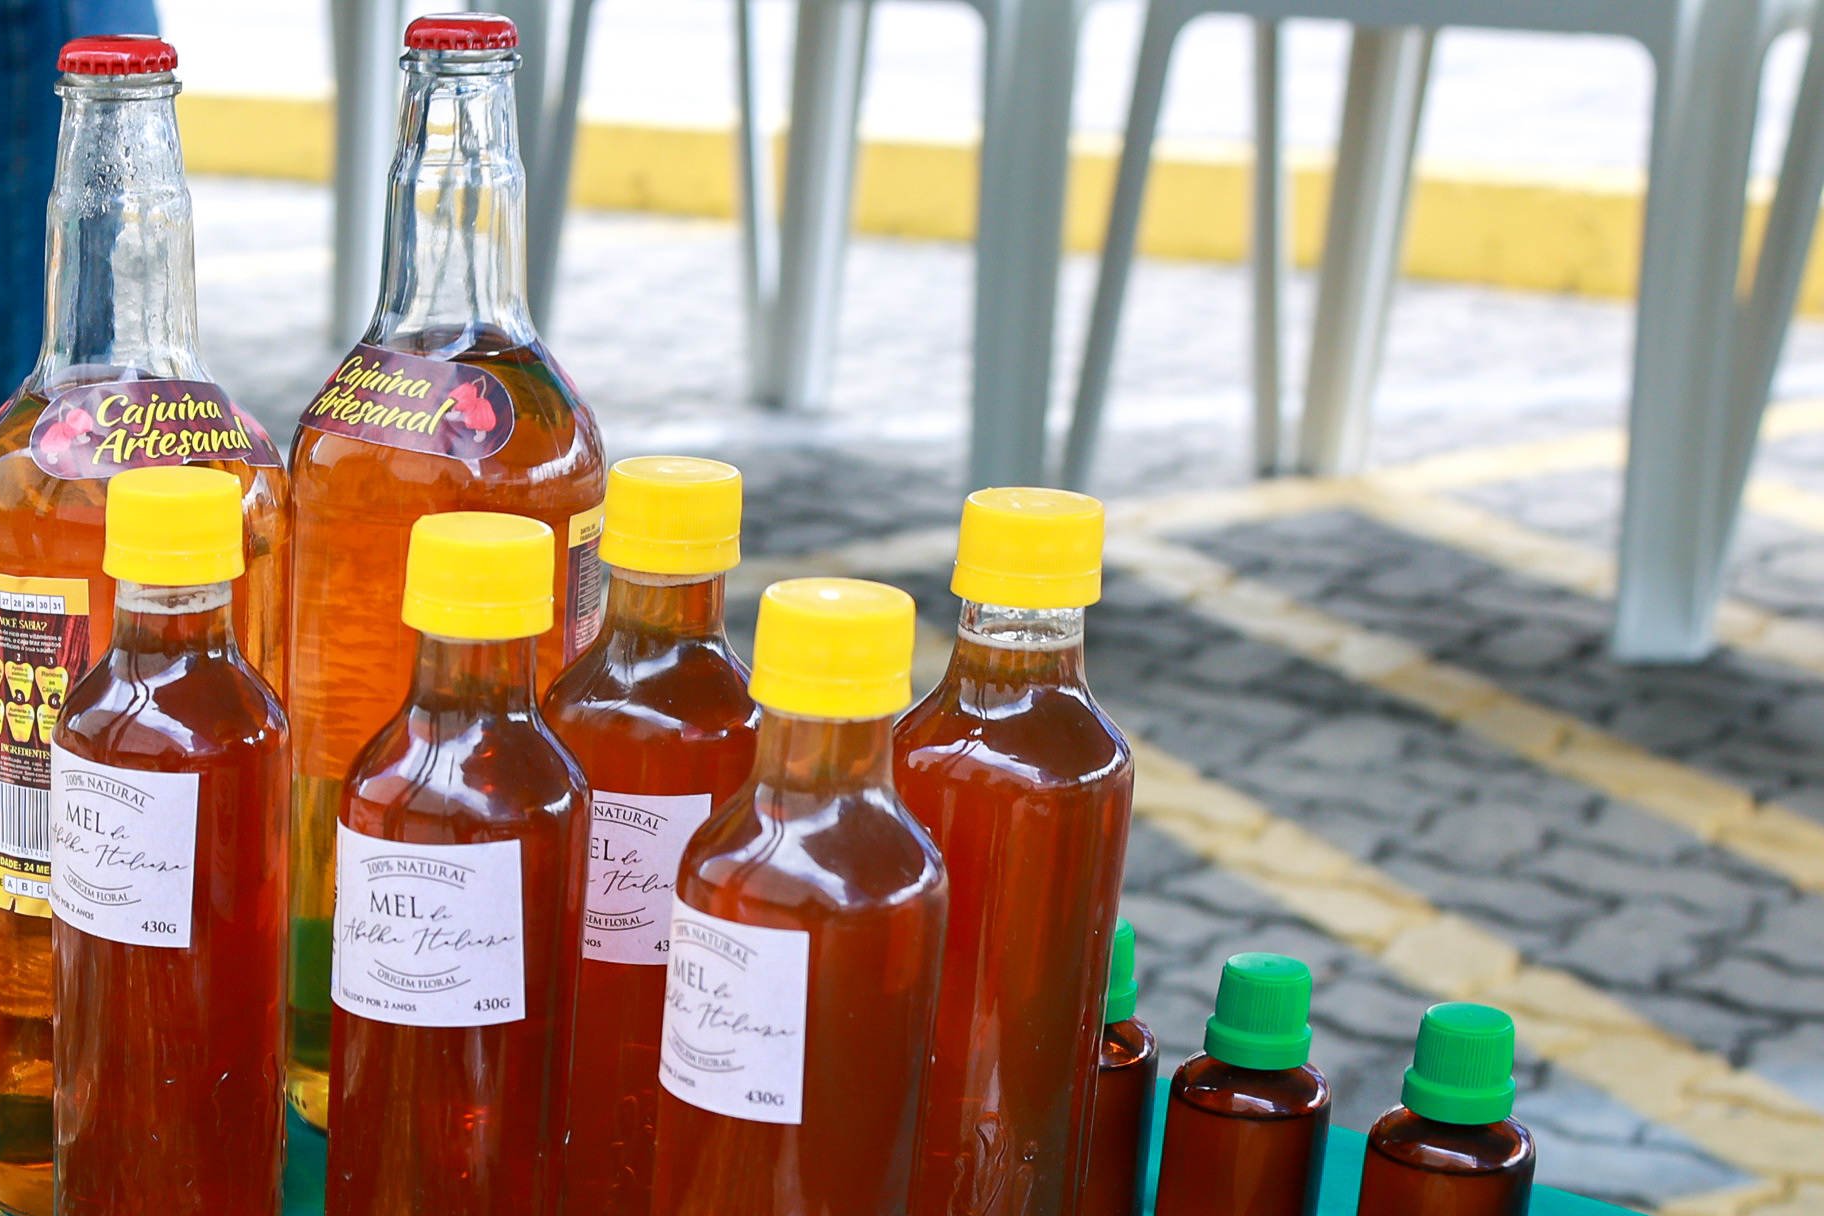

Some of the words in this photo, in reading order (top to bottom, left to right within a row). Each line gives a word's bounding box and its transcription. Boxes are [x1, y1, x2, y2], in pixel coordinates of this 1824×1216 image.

[335, 355, 433, 399] Cajuína
[95, 392, 223, 437] Cajuína
[308, 385, 457, 436] Artesanal
[91, 415, 254, 465] Artesanal
[53, 602, 61, 610] 31
[16, 653, 21, 661] 2
[65, 774, 85, 787] 100%
[86, 776, 146, 808] NATURAL
[65, 801, 106, 836] MEL
[594, 805, 659, 831] NATURAL
[589, 837, 616, 862] EL
[23, 862, 35, 873] 24
[366, 860, 394, 875] 100%
[396, 860, 467, 884] NATURAL
[21, 882, 28, 892] B
[36, 885, 44, 895] C
[603, 869, 675, 896] Italia
[96, 892, 130, 902] FLORAL
[369, 890, 424, 920] MEL
[429, 905, 453, 922] de
[71, 903, 76, 912] 2
[76, 908, 95, 921] ANOS
[604, 916, 642, 927] FLORAL
[141, 920, 178, 934] 430G
[342, 917, 405, 945] Abelha
[412, 927, 516, 956] Italiana
[584, 938, 602, 948] NOS
[653, 939, 671, 952] 43
[691, 927, 749, 965] NATURAL
[377, 968, 415, 989] ORIGEM
[417, 975, 459, 989] FLORAL
[672, 952, 709, 994] MEL
[365, 998, 382, 1008] POR
[383, 1000, 390, 1009] 2
[391, 1003, 417, 1012] ANOS
[473, 997, 511, 1012] 430G
[744, 1089, 786, 1107] 430G
